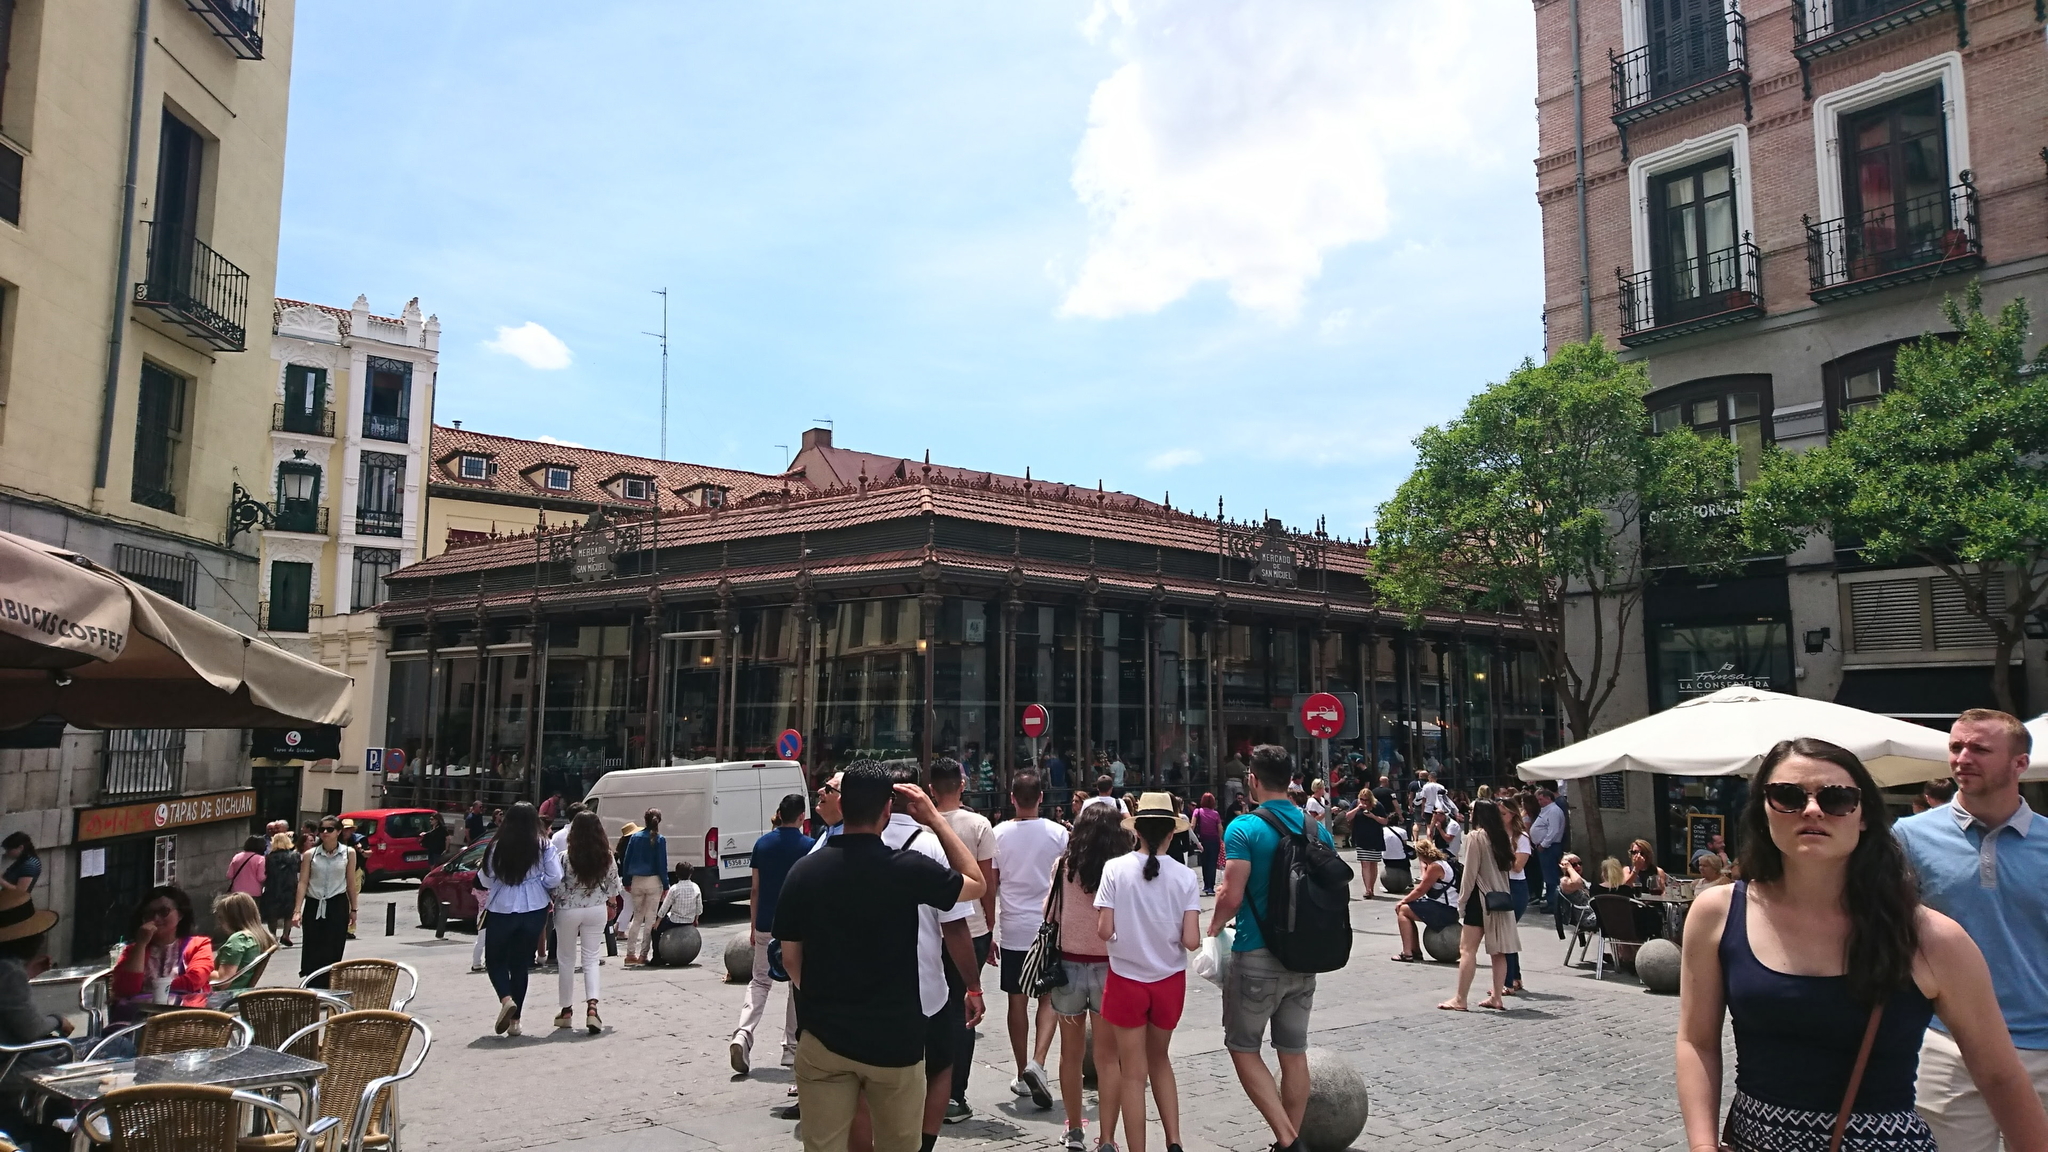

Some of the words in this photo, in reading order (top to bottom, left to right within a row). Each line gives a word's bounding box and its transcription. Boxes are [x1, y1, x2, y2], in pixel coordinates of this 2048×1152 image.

[578, 546, 607, 557] MERCADO
[1261, 553, 1291, 564] MERCADO
[576, 565, 587, 574] SAN
[587, 562, 607, 572] MIGUEL
[1261, 568, 1273, 577] SAN
[1273, 570, 1292, 580] MIGUEL
[58, 619, 123, 654] COFFEE
[1695, 671, 1752, 682] Frinsa
[1680, 682, 1693, 690] LA
[370, 750, 378, 770] P
[169, 802, 198, 824] TAPAS
[200, 801, 212, 818] DE
[215, 795, 253, 817] SICHUAN
